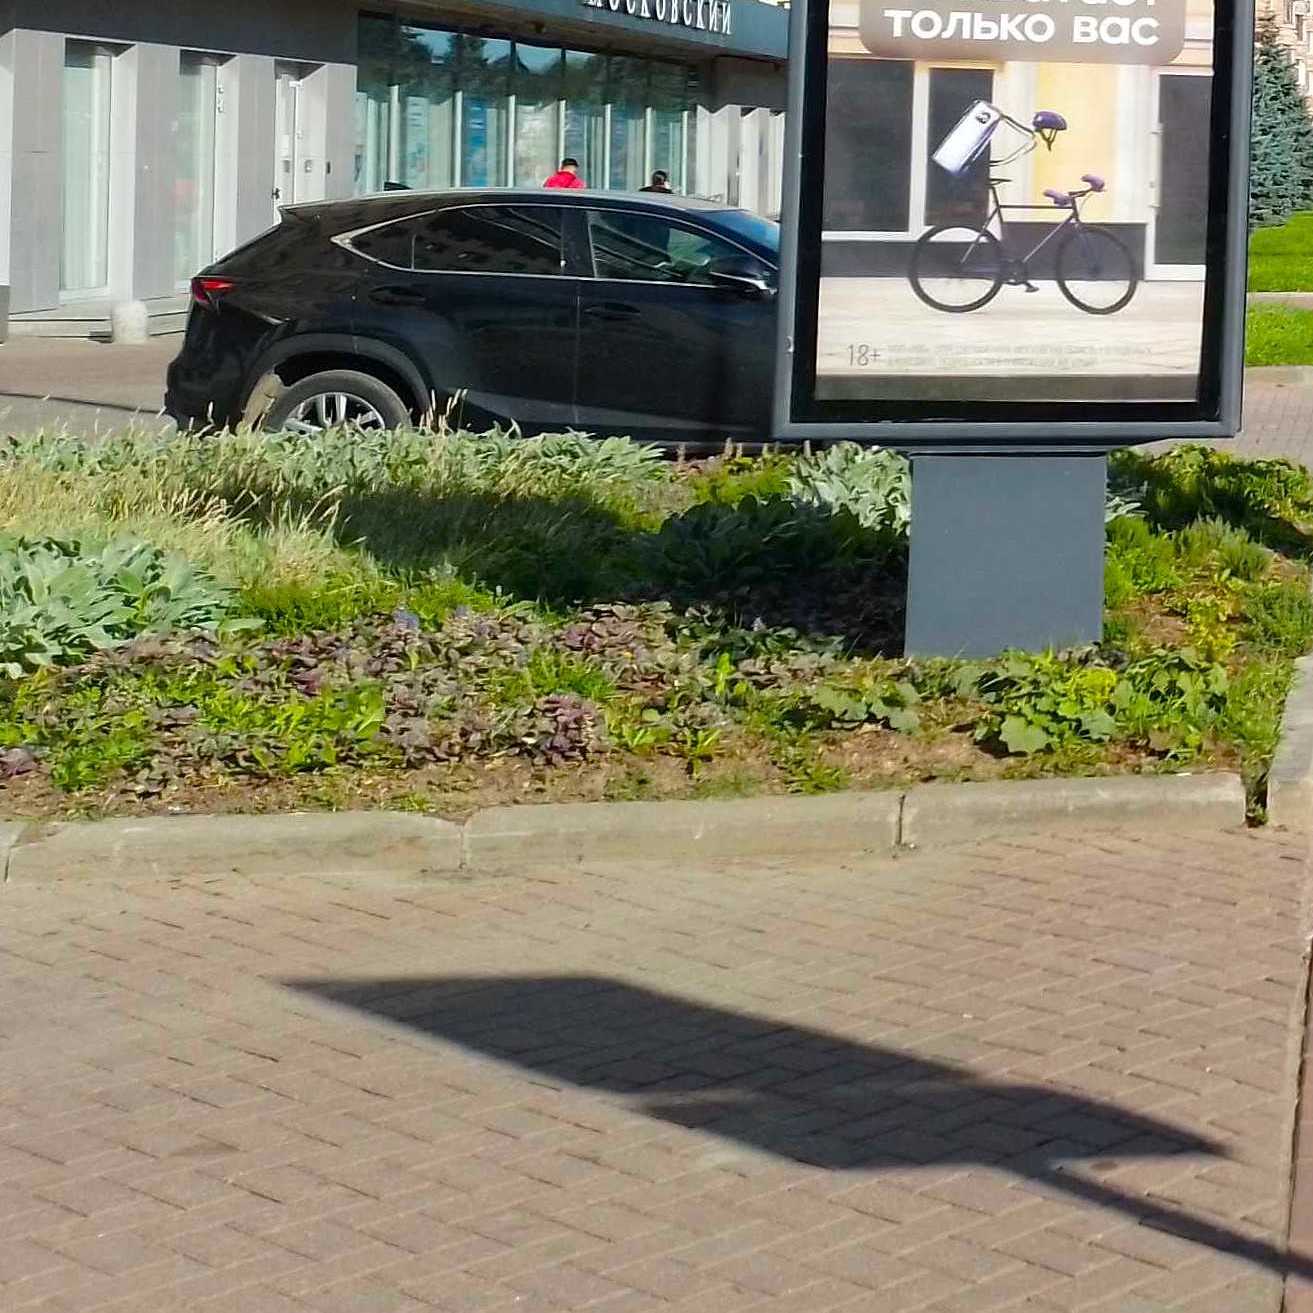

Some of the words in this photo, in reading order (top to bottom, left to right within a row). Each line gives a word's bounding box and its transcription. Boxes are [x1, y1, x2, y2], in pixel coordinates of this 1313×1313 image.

[884, 8, 1056, 43] только
[1072, 14, 1160, 45] вас
[847, 343, 881, 367] 18+
